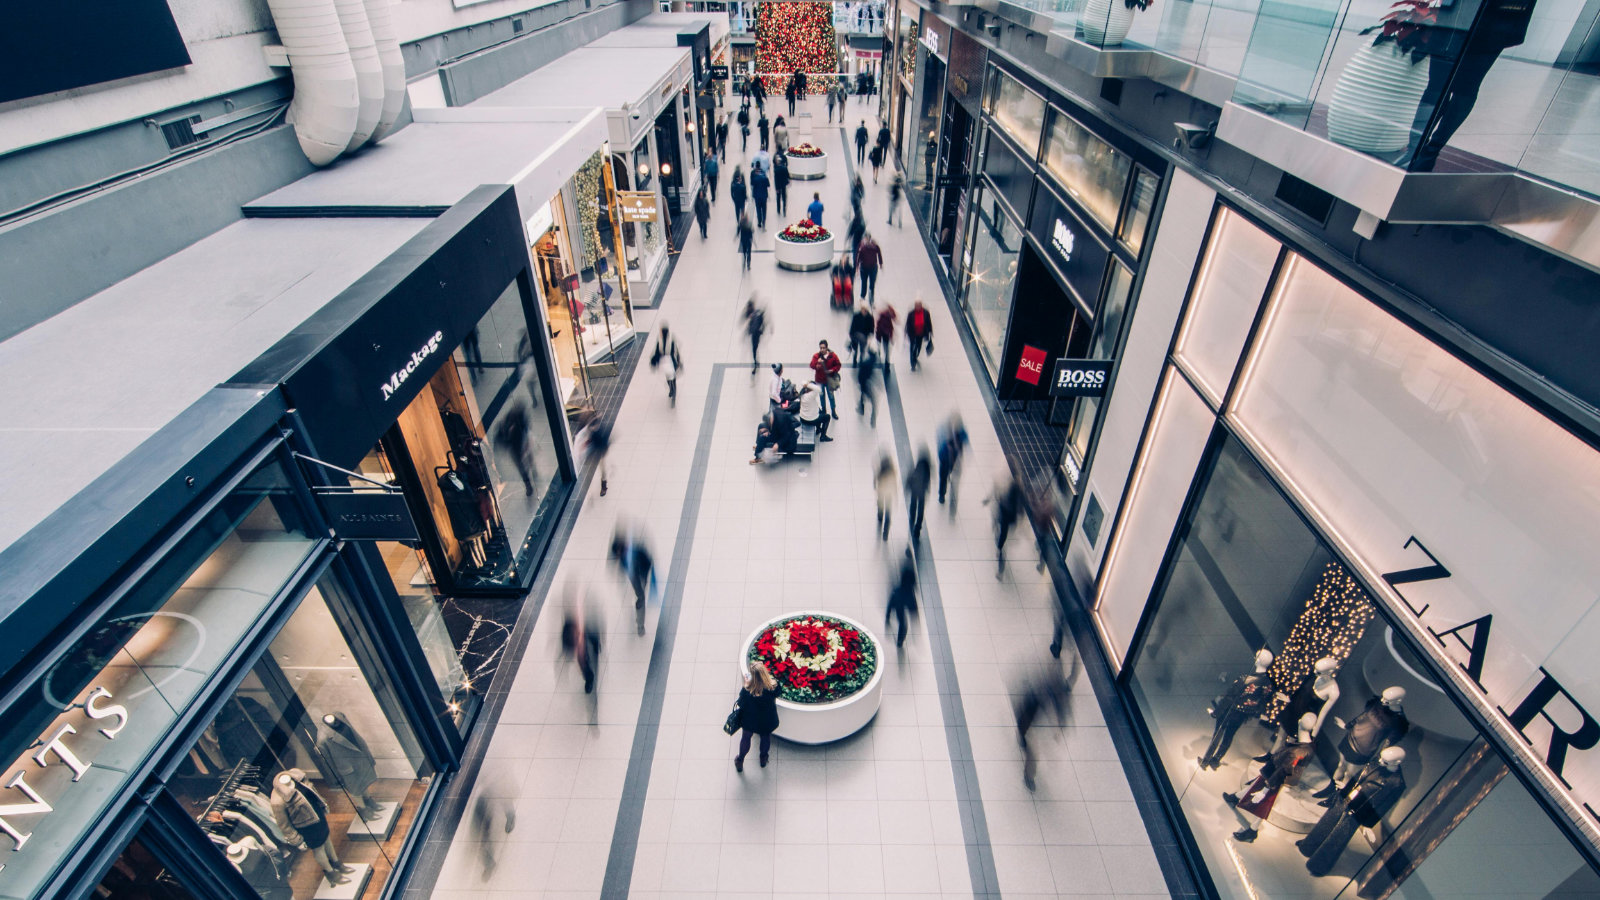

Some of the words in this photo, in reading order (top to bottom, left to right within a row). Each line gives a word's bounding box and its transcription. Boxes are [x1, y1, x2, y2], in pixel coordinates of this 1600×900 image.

[380, 329, 444, 402] Mackage
[1020, 358, 1043, 373] SALE
[1058, 369, 1105, 384] BOSS
[1382, 535, 1600, 823] ZAR
[0, 686, 129, 872] NTS
